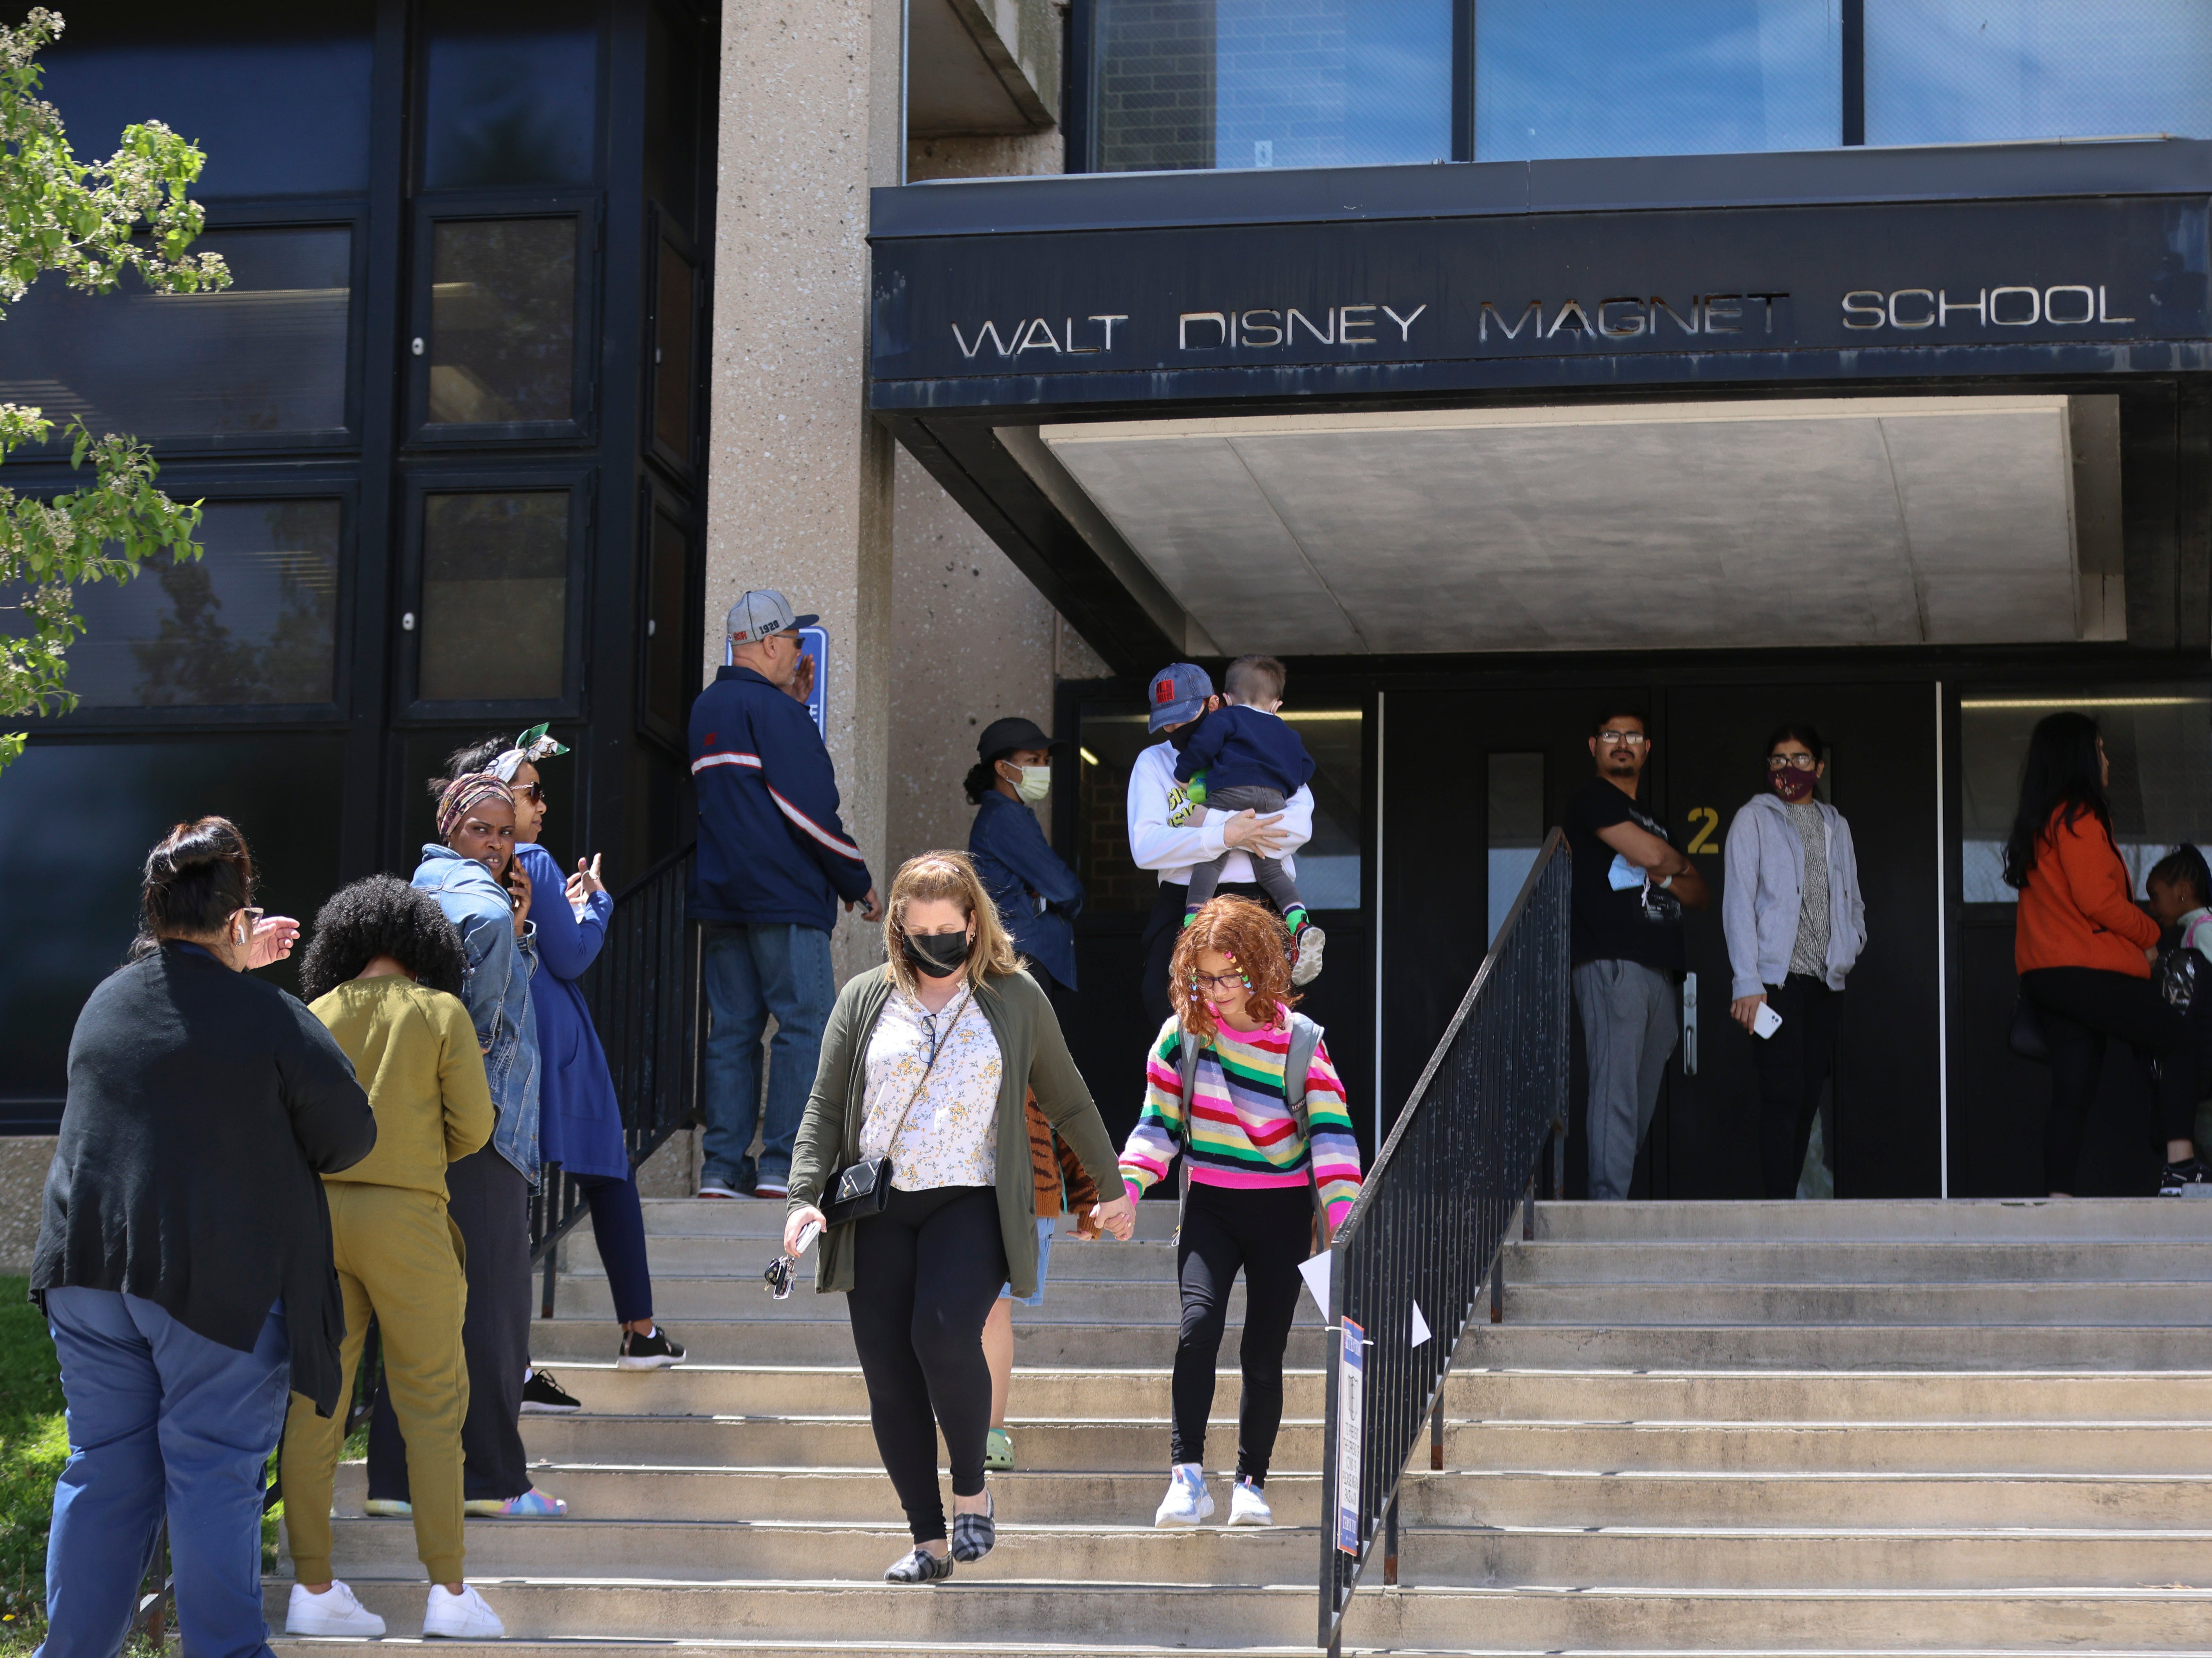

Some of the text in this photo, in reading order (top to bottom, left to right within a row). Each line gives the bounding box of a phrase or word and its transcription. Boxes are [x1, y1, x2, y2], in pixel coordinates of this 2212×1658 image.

[951, 285, 2136, 357] WALT DISNEY MAGNET SCHOOL
[759, 620, 780, 635] 1920
[1688, 808, 1719, 854] 2
[1345, 1334, 1361, 1357] ATTENTION
[1343, 1515, 1351, 1531] THANK
